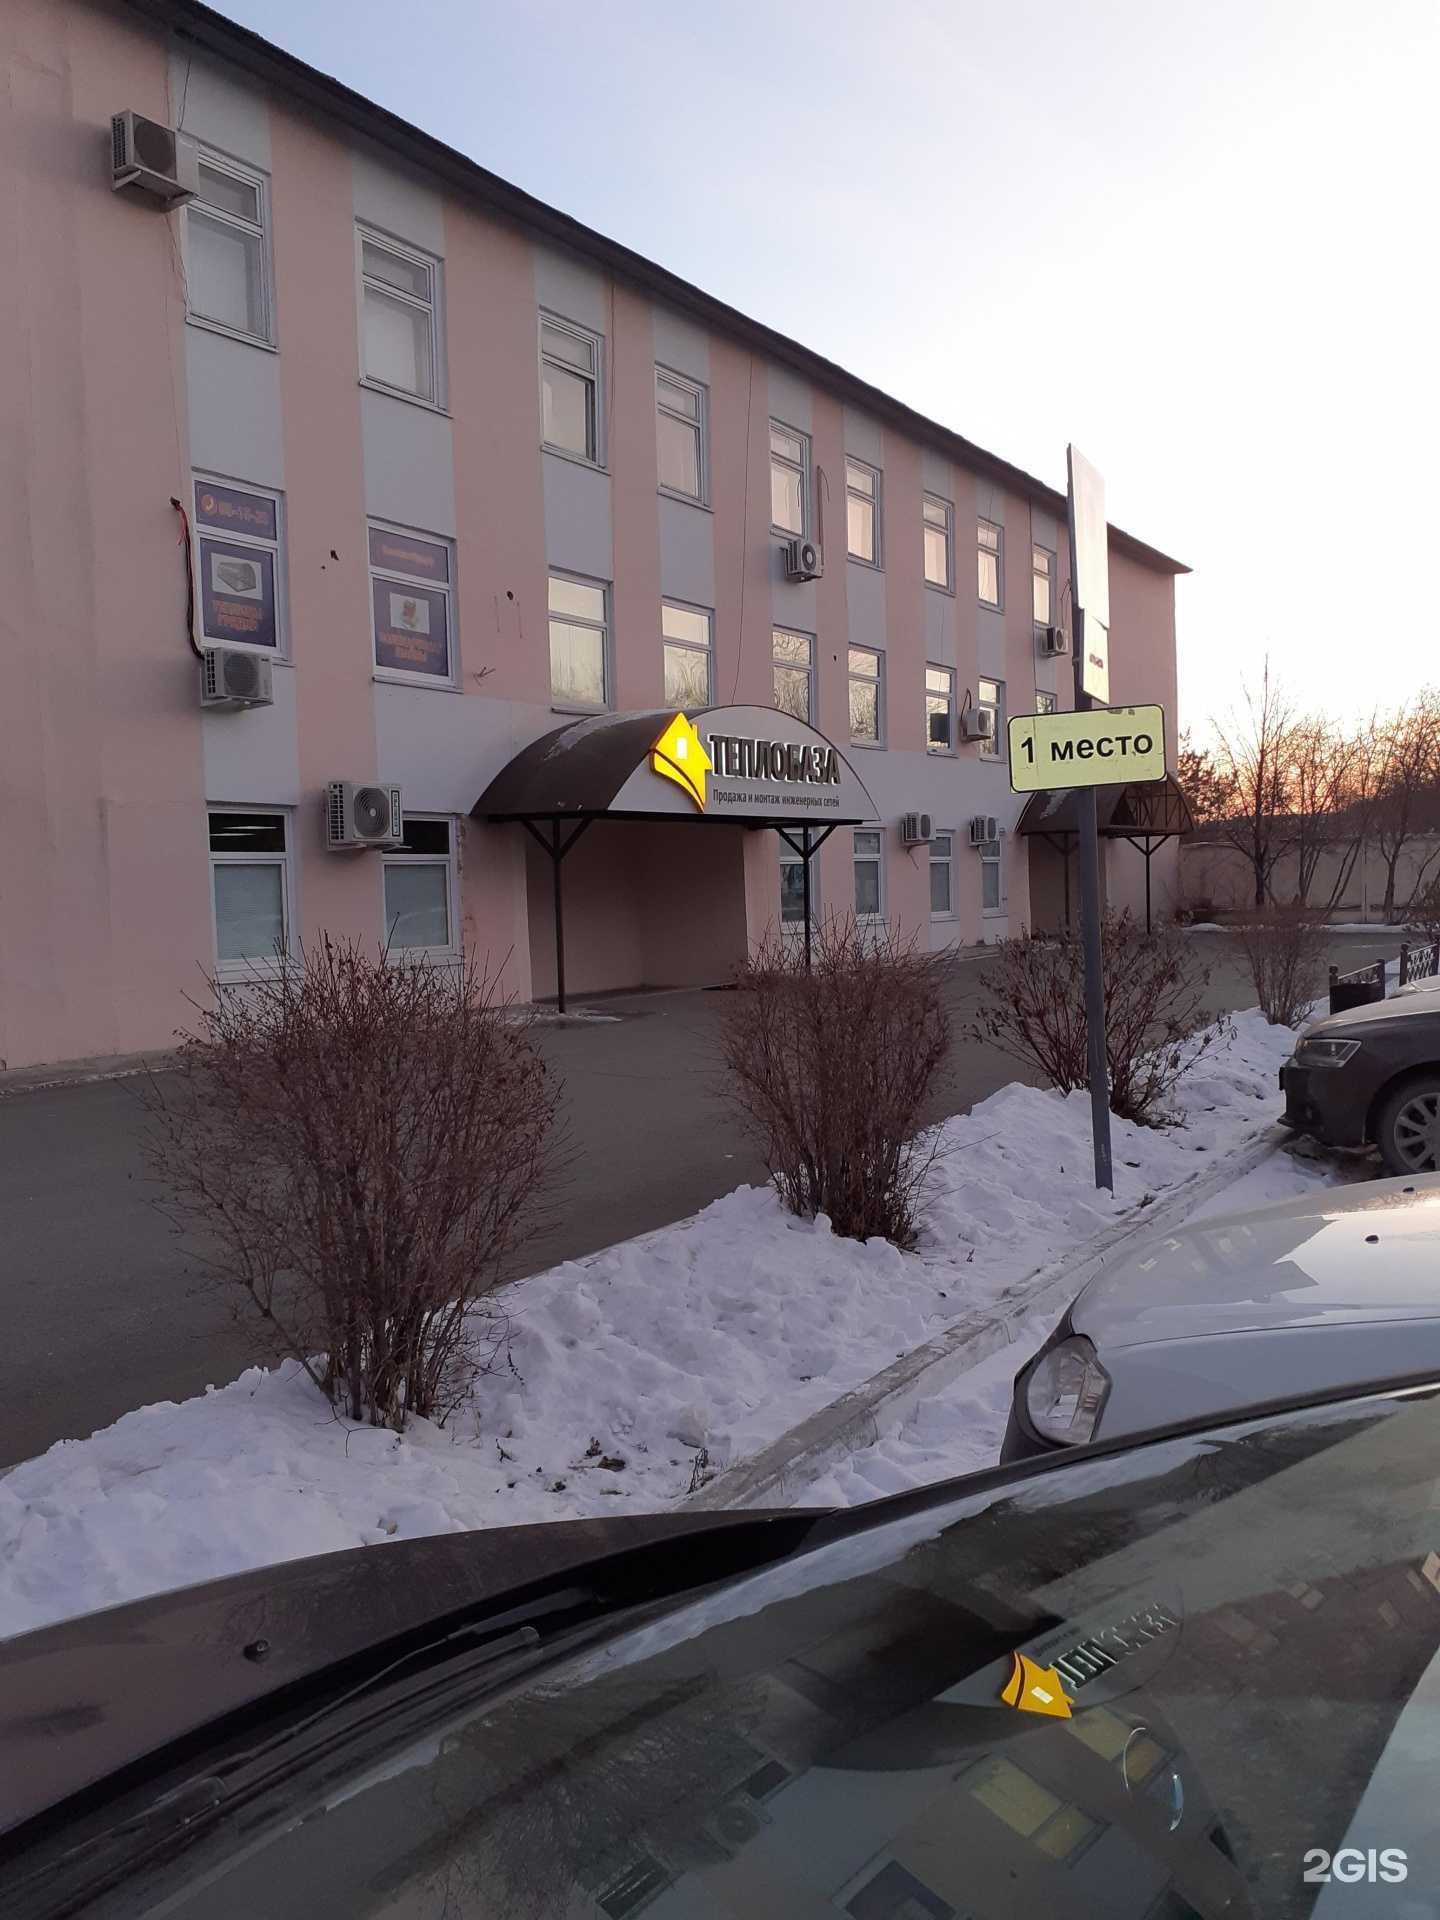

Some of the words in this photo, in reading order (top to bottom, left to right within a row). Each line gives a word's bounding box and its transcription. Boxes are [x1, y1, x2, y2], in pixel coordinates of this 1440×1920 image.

[707, 733, 841, 785] ТЕПЛОБАЗА
[1021, 736, 1034, 764] 1
[1051, 734, 1153, 762] место
[713, 788, 747, 806] Продажа
[754, 793, 780, 804] монтаж
[781, 795, 822, 810] инженерных
[823, 795, 840, 808] сетей
